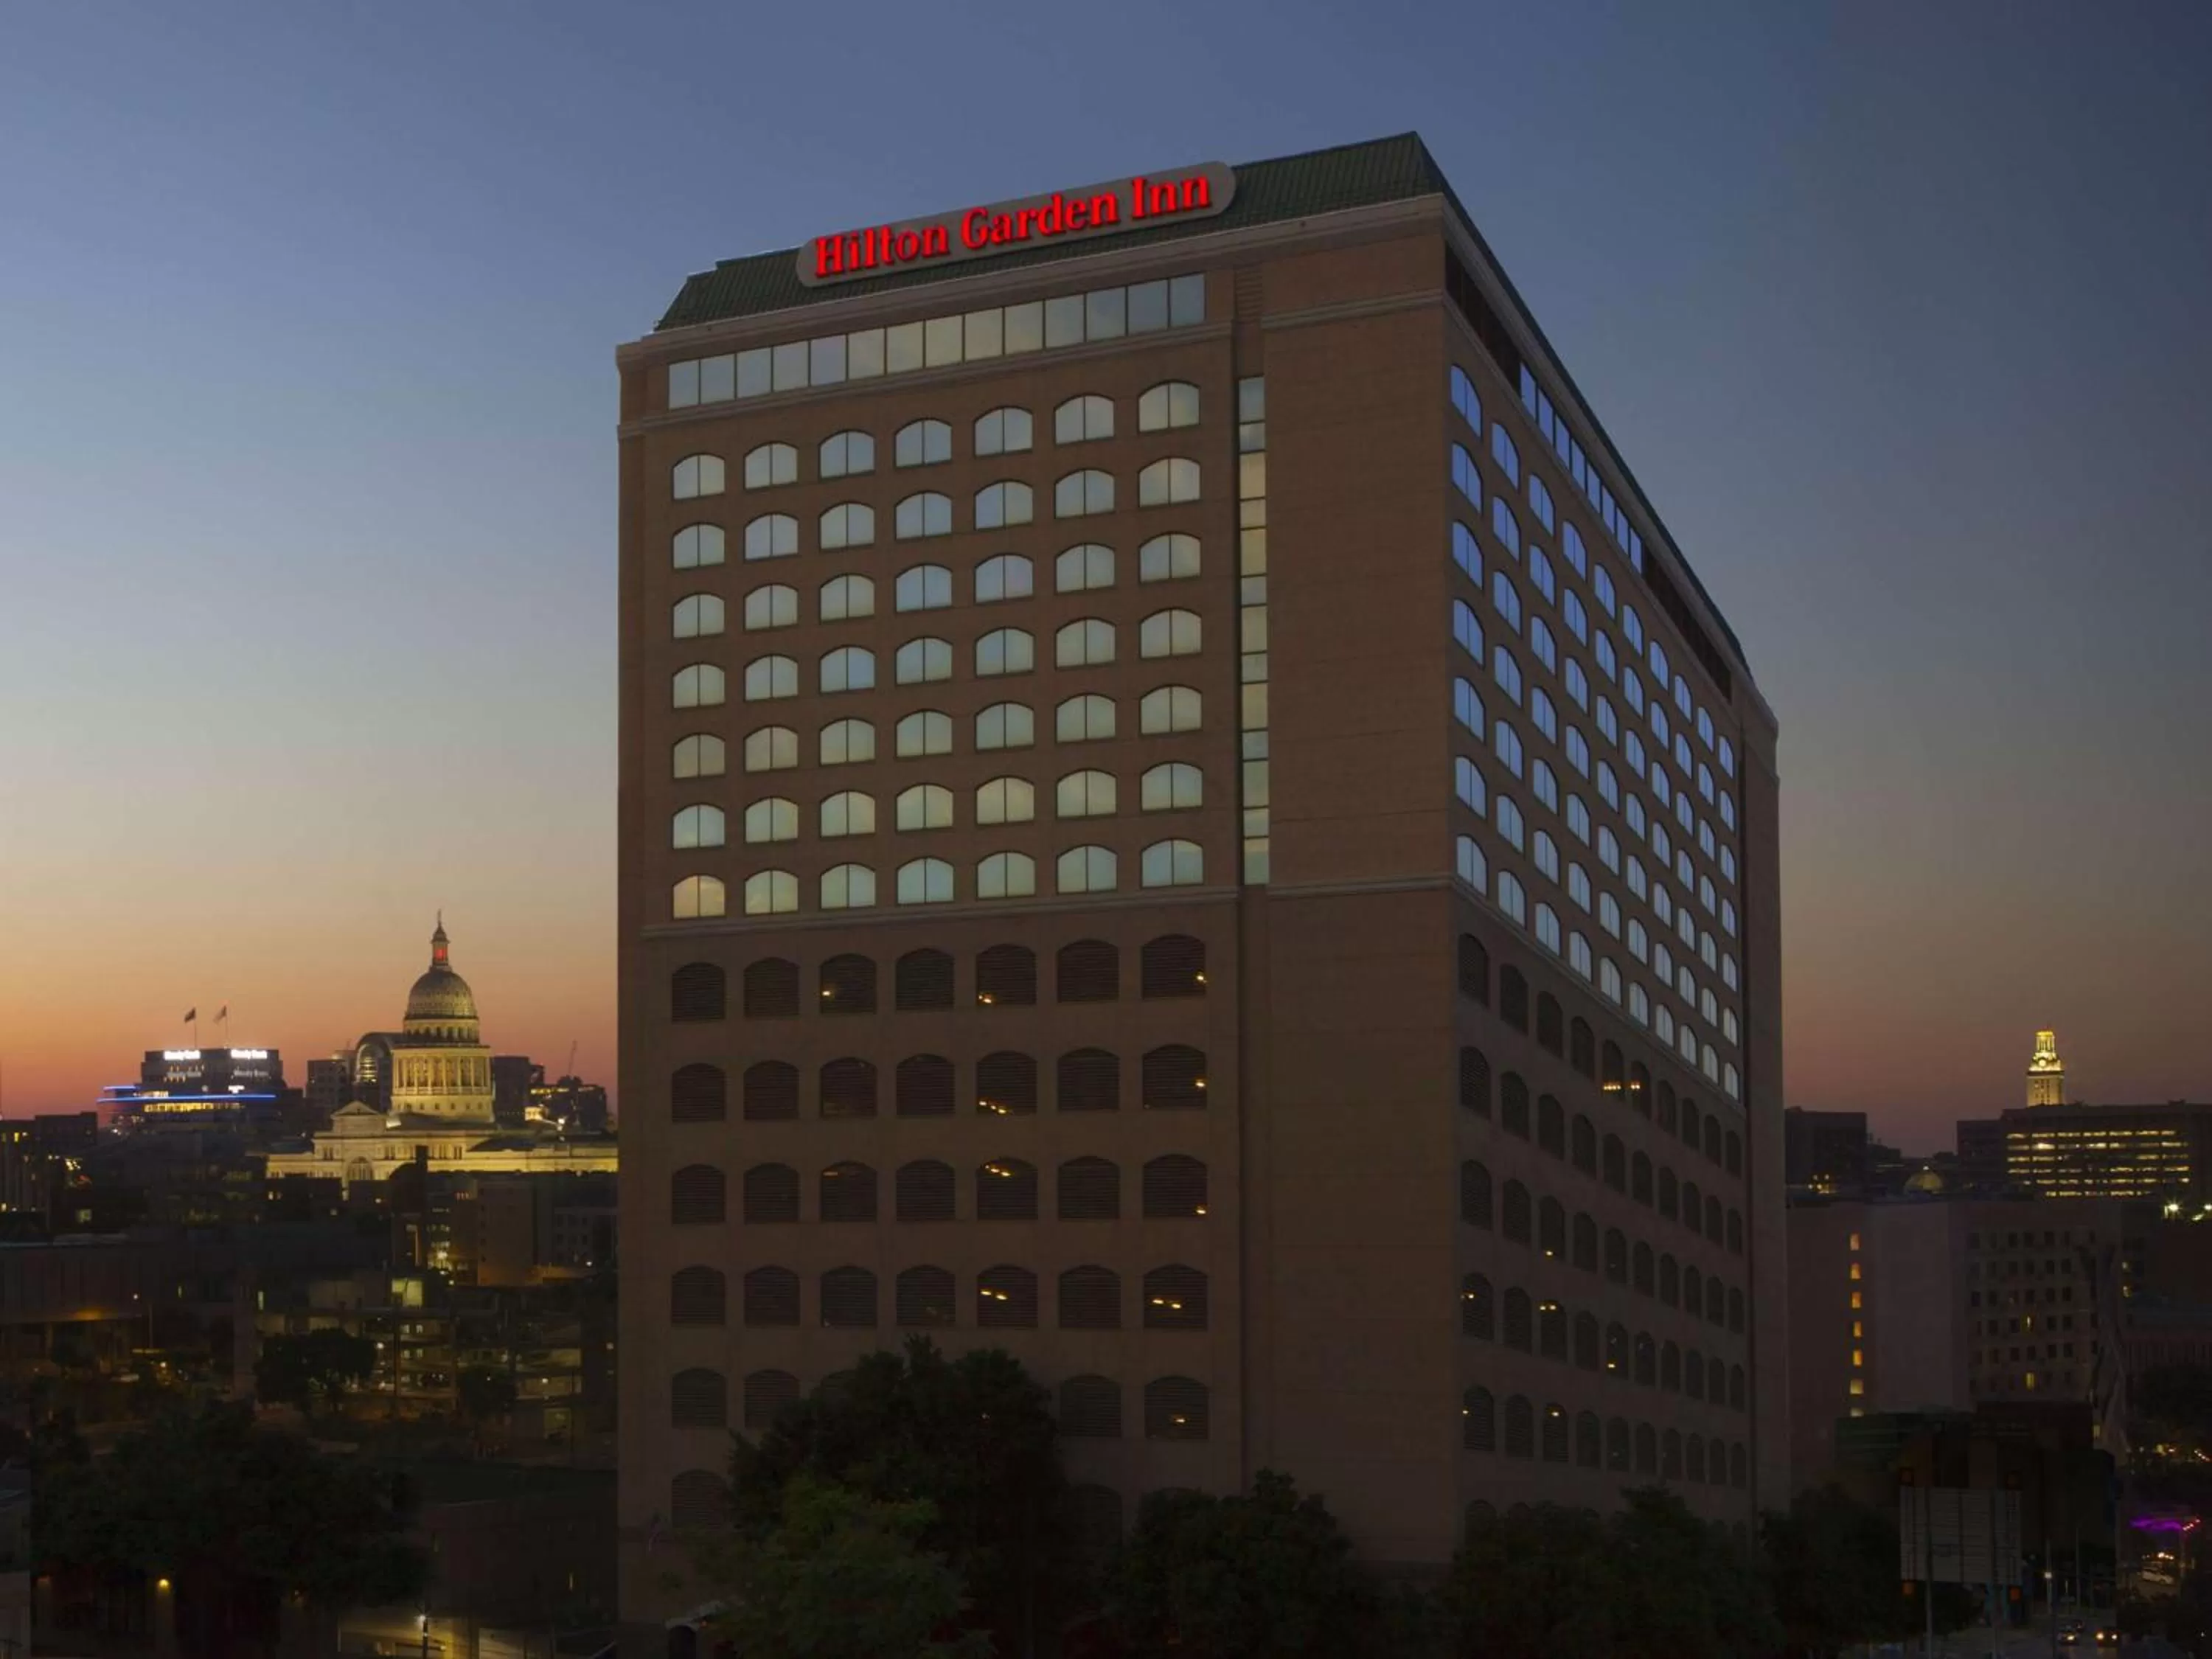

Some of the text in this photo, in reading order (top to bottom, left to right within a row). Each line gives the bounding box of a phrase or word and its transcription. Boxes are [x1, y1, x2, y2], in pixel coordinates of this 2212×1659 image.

[815, 175, 1210, 276] Hilton Garden Inn
